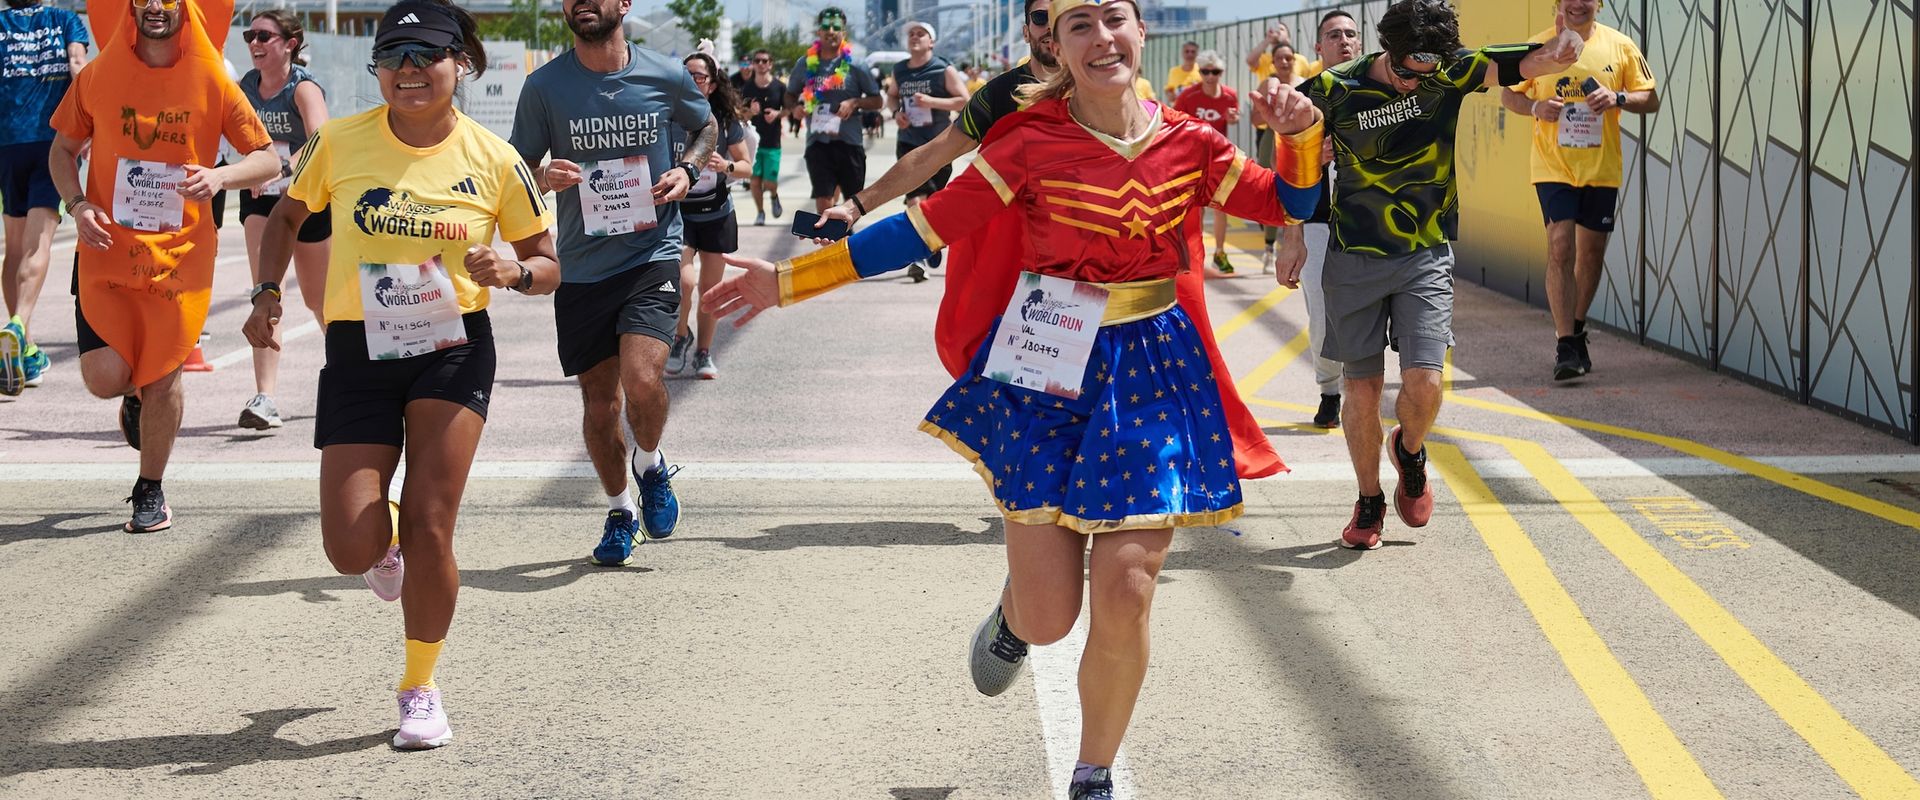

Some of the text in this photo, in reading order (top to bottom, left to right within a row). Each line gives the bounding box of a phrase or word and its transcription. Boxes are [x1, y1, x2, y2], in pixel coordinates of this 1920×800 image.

[53, 37, 61, 46] A
[486, 84, 503, 96] KM
[1563, 89, 1586, 97] WORL
[1357, 95, 1418, 120] MIDNIGHT
[569, 112, 660, 135] MIDNIGHT
[1359, 105, 1422, 130] RUNNERS
[571, 129, 658, 150] RUNNERS
[134, 179, 176, 191] WORLD RUN
[597, 178, 640, 193] WORLD RUN
[389, 201, 431, 214] WINGS
[371, 215, 468, 240] WORLD RUN
[385, 289, 442, 306] WORLD RUN
[1028, 308, 1084, 332] WORLD RUN
[1022, 324, 1035, 336] VAL
